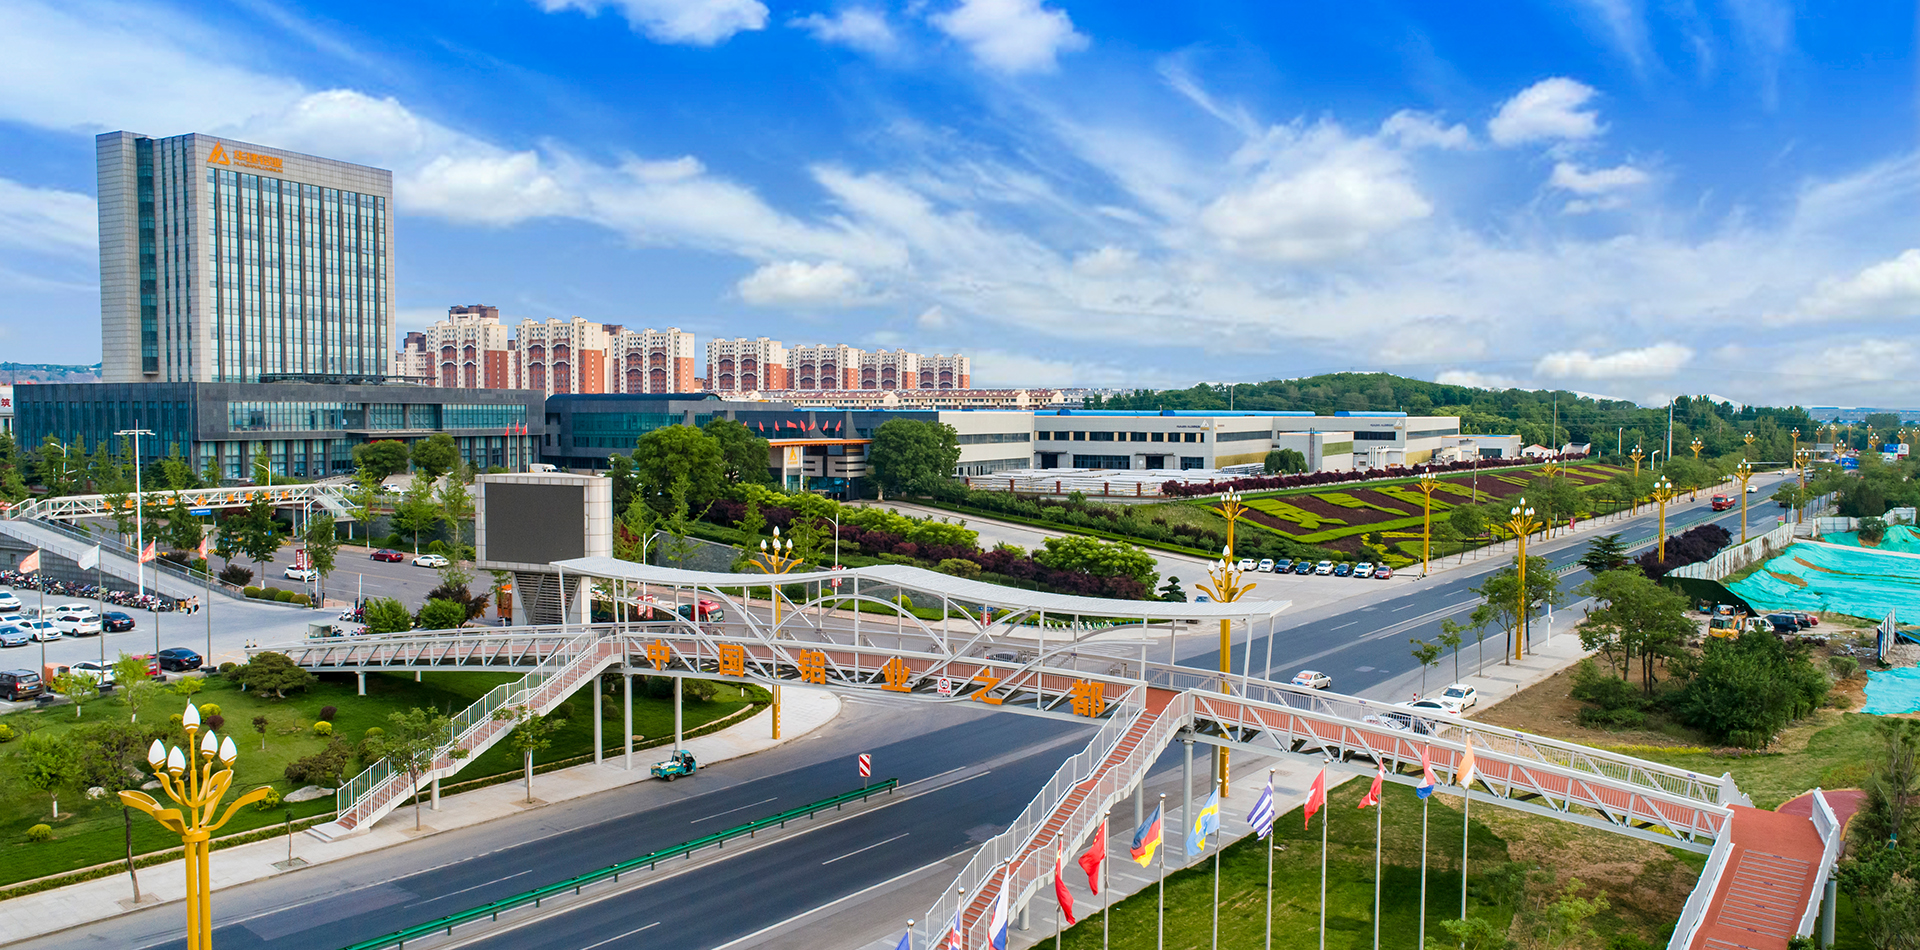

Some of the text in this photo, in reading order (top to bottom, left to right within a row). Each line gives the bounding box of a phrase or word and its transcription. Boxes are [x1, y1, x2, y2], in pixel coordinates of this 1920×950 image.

[647, 639, 1105, 718] 中国铝业之都
